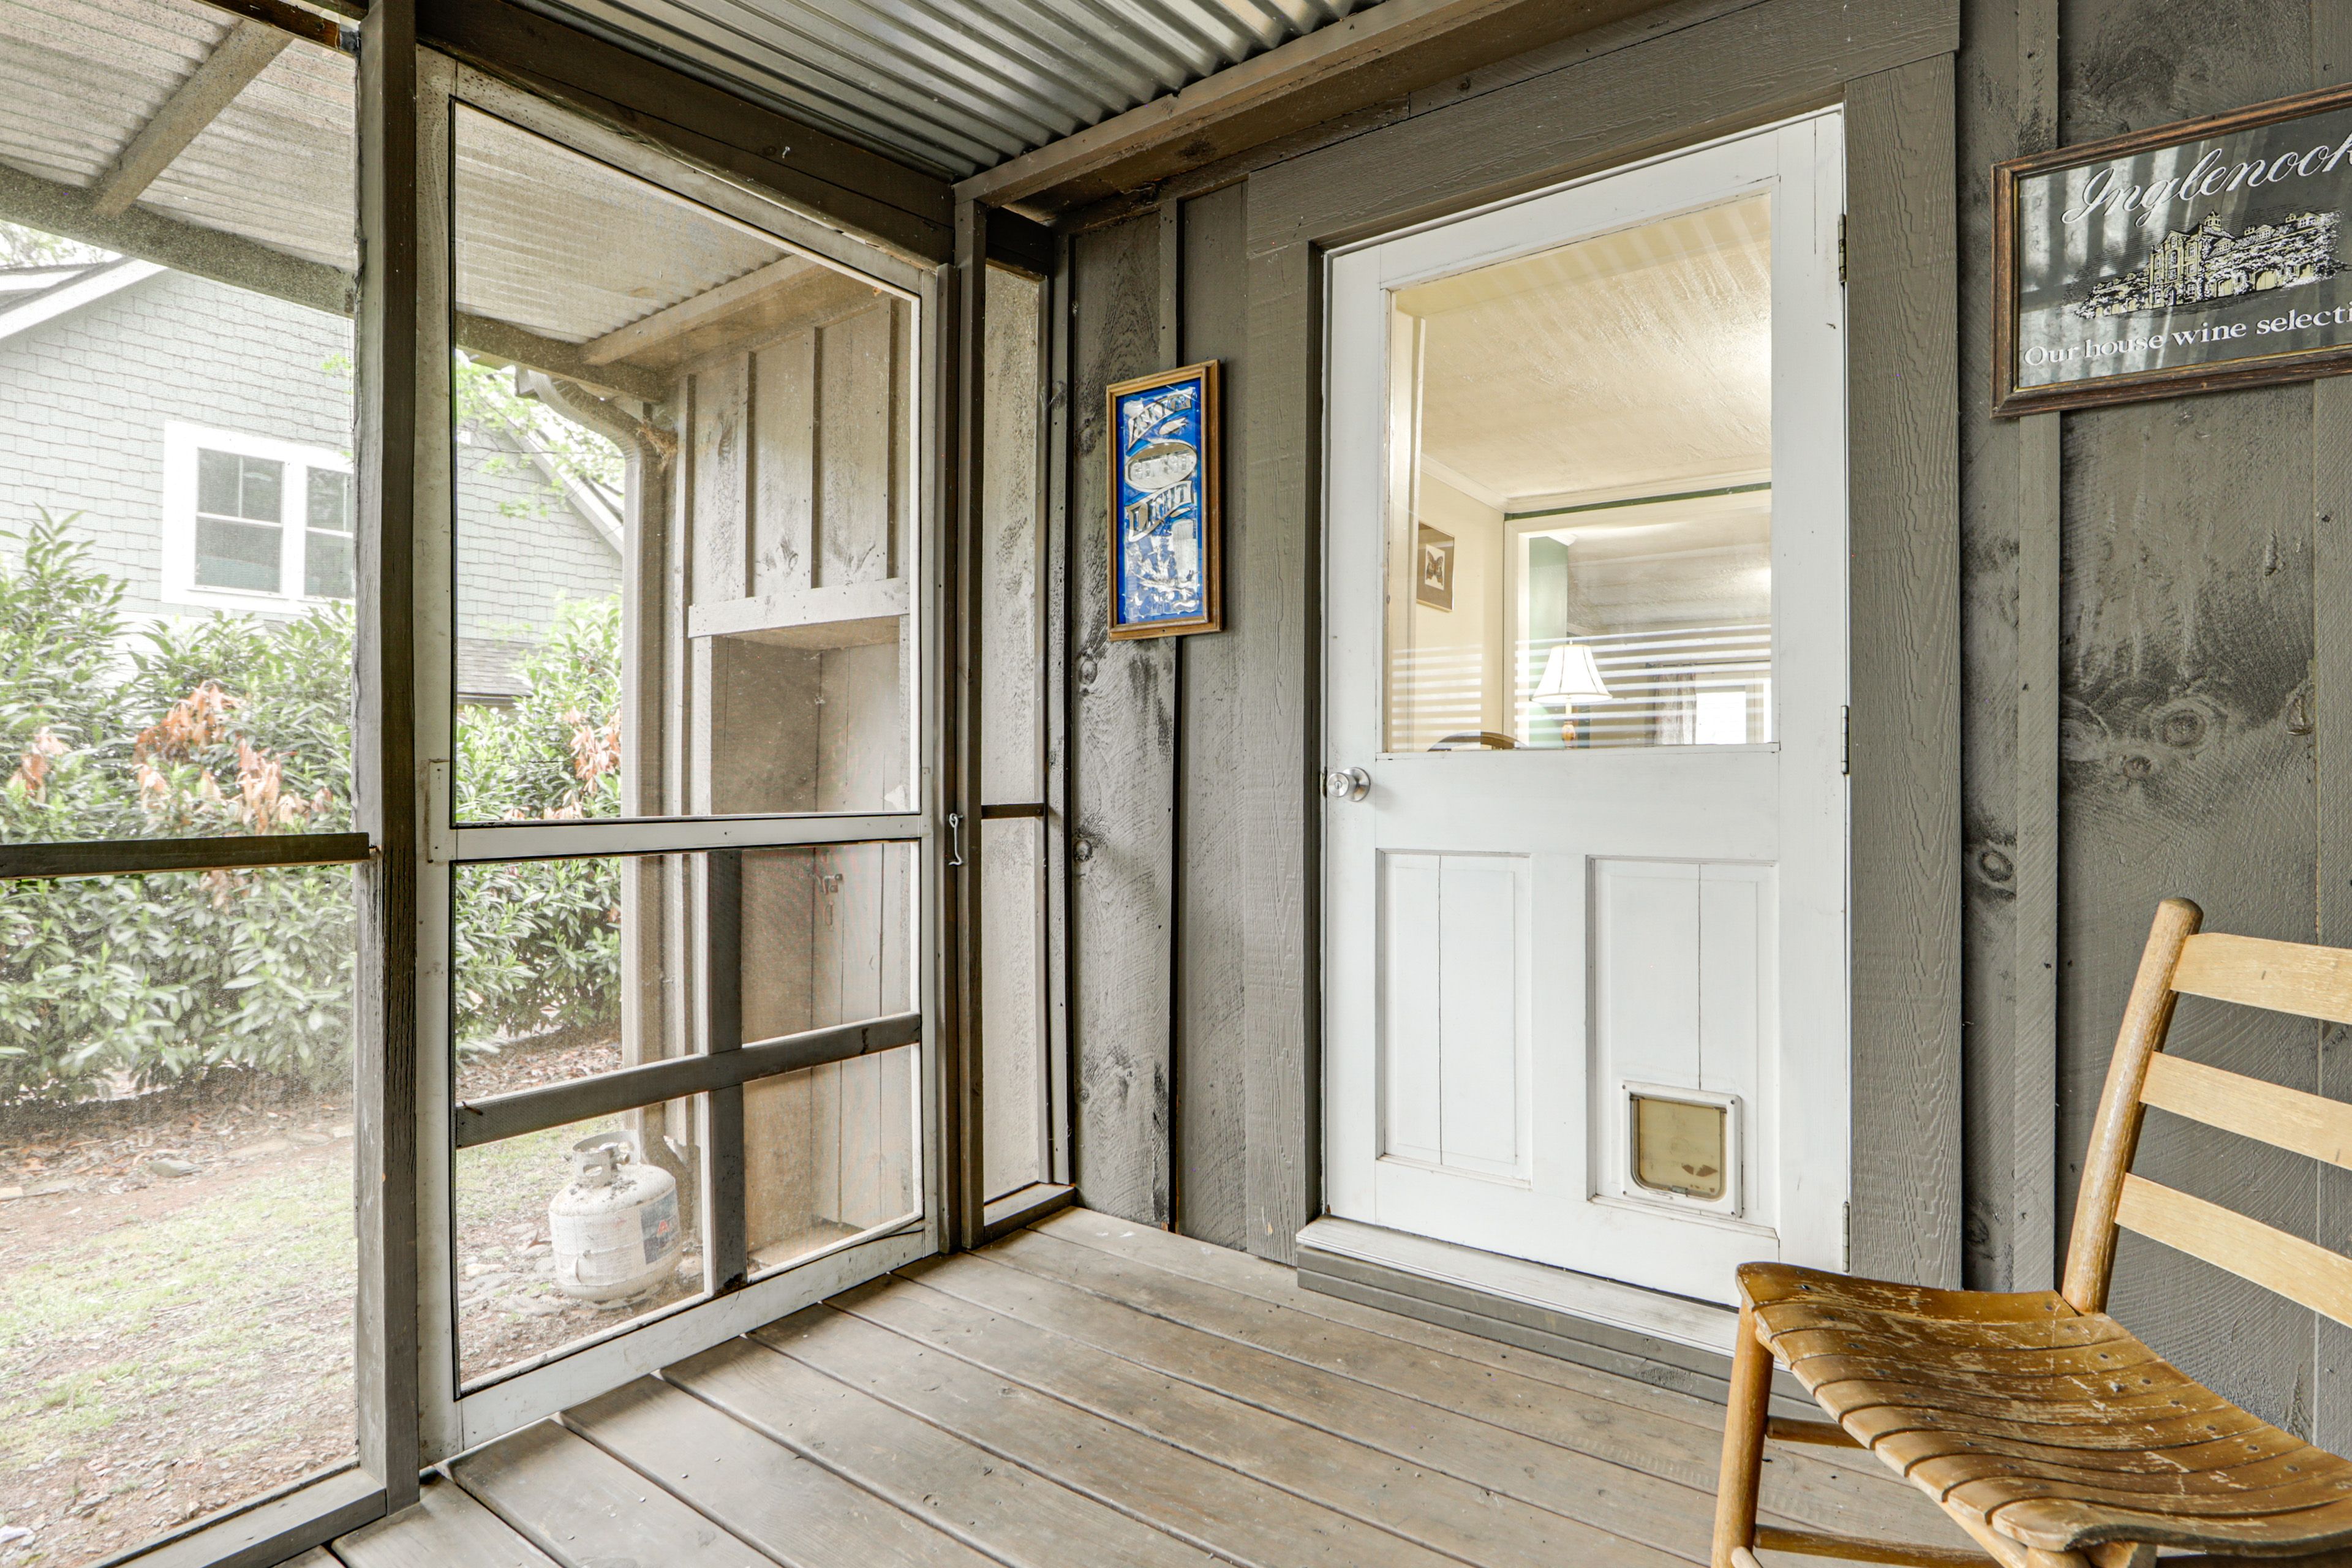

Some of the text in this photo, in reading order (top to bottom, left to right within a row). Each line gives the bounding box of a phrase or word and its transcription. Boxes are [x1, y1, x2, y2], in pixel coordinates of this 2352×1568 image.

[2060, 131, 2352, 228] Inglenook
[2024, 345, 2079, 366] Our
[2084, 334, 2164, 358] house
[2171, 322, 2247, 346] wine
